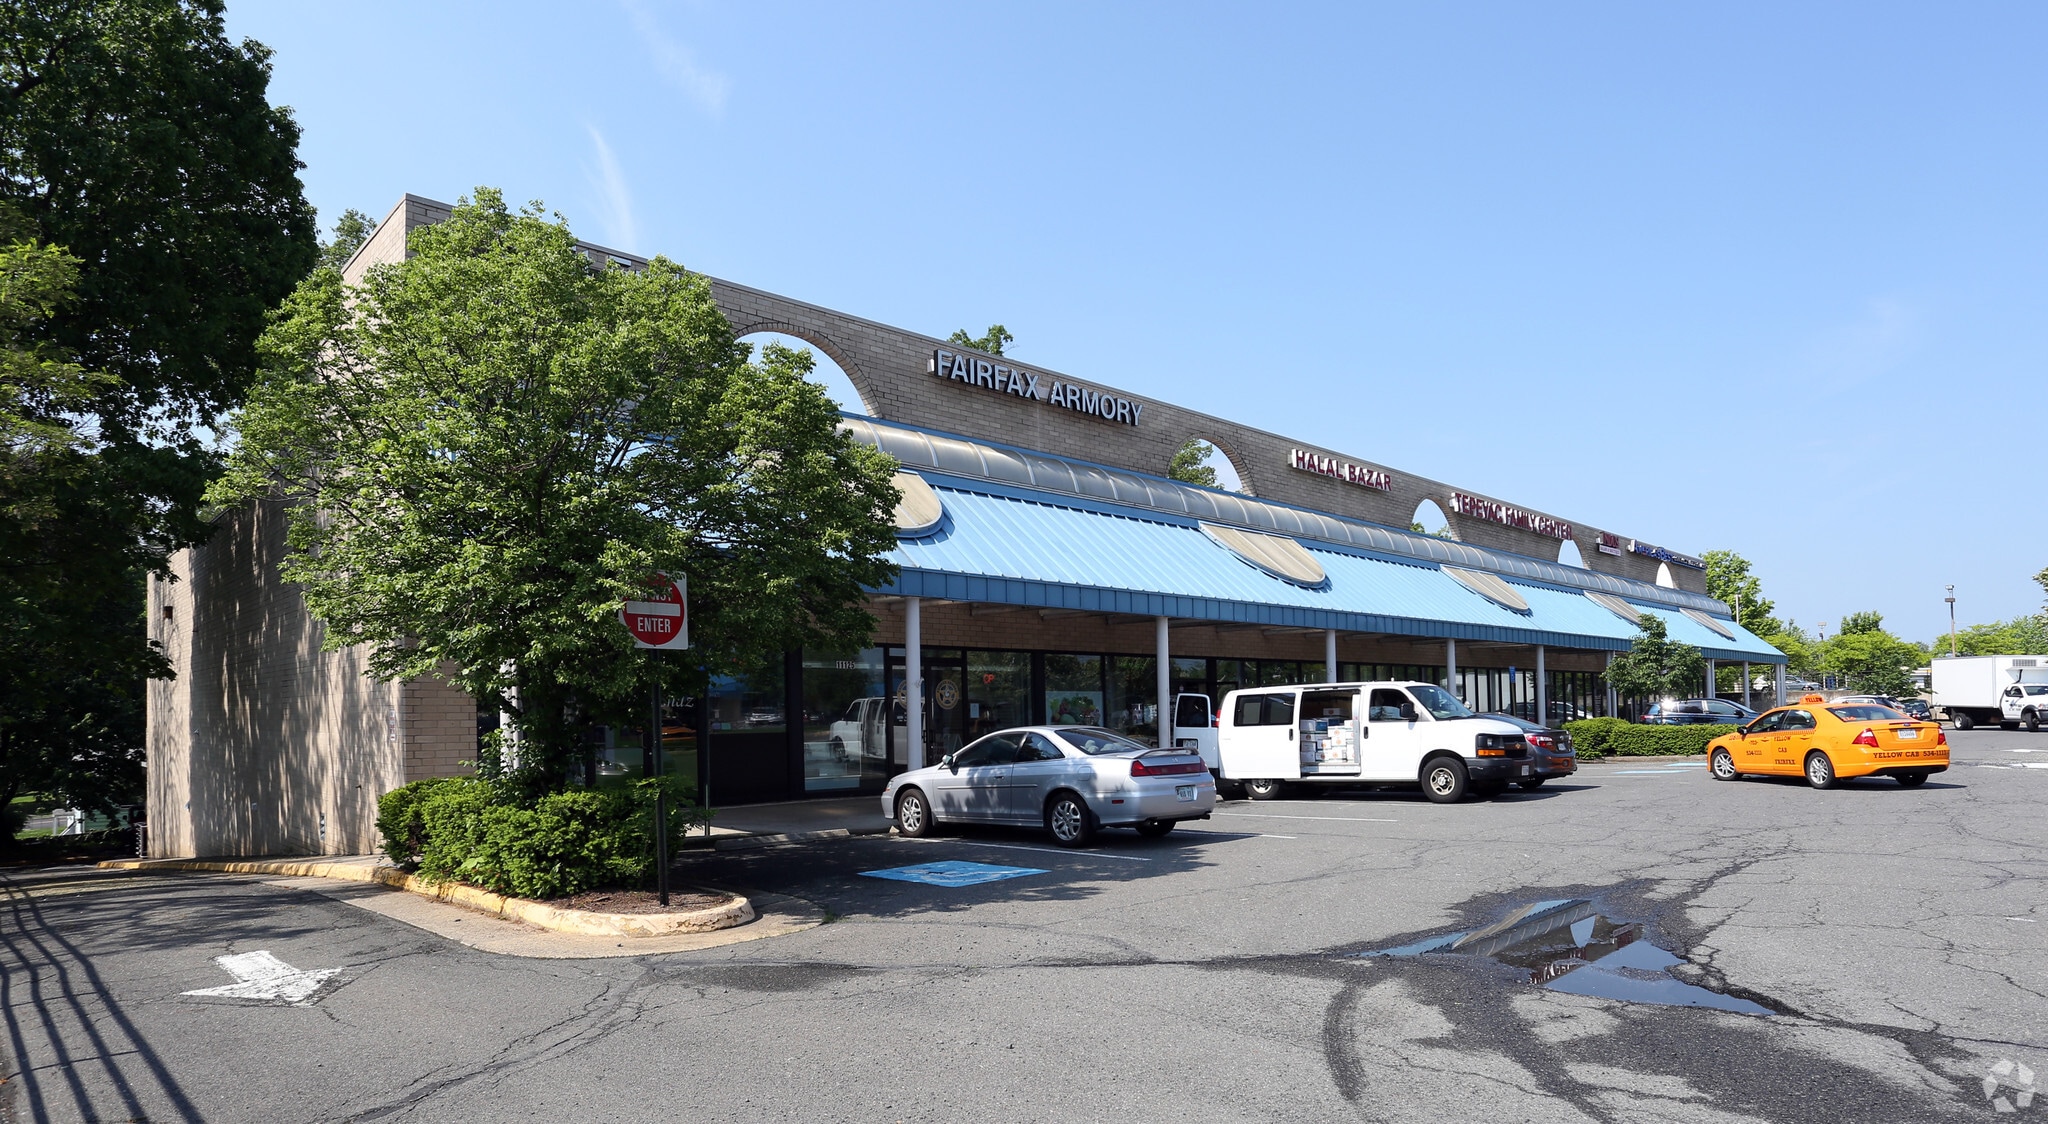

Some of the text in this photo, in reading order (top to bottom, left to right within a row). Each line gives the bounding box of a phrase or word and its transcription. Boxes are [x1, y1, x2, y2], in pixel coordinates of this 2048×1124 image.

[934, 349, 1143, 427] FAIRFAX ARMORY
[1294, 450, 1392, 491] HALAL BAZAR
[1454, 492, 1572, 540] TEPEYAC FAMILY CENTER
[637, 617, 671, 633] ENTER
[836, 660, 856, 670] 11125
[1873, 751, 1903, 759] YELLOW
